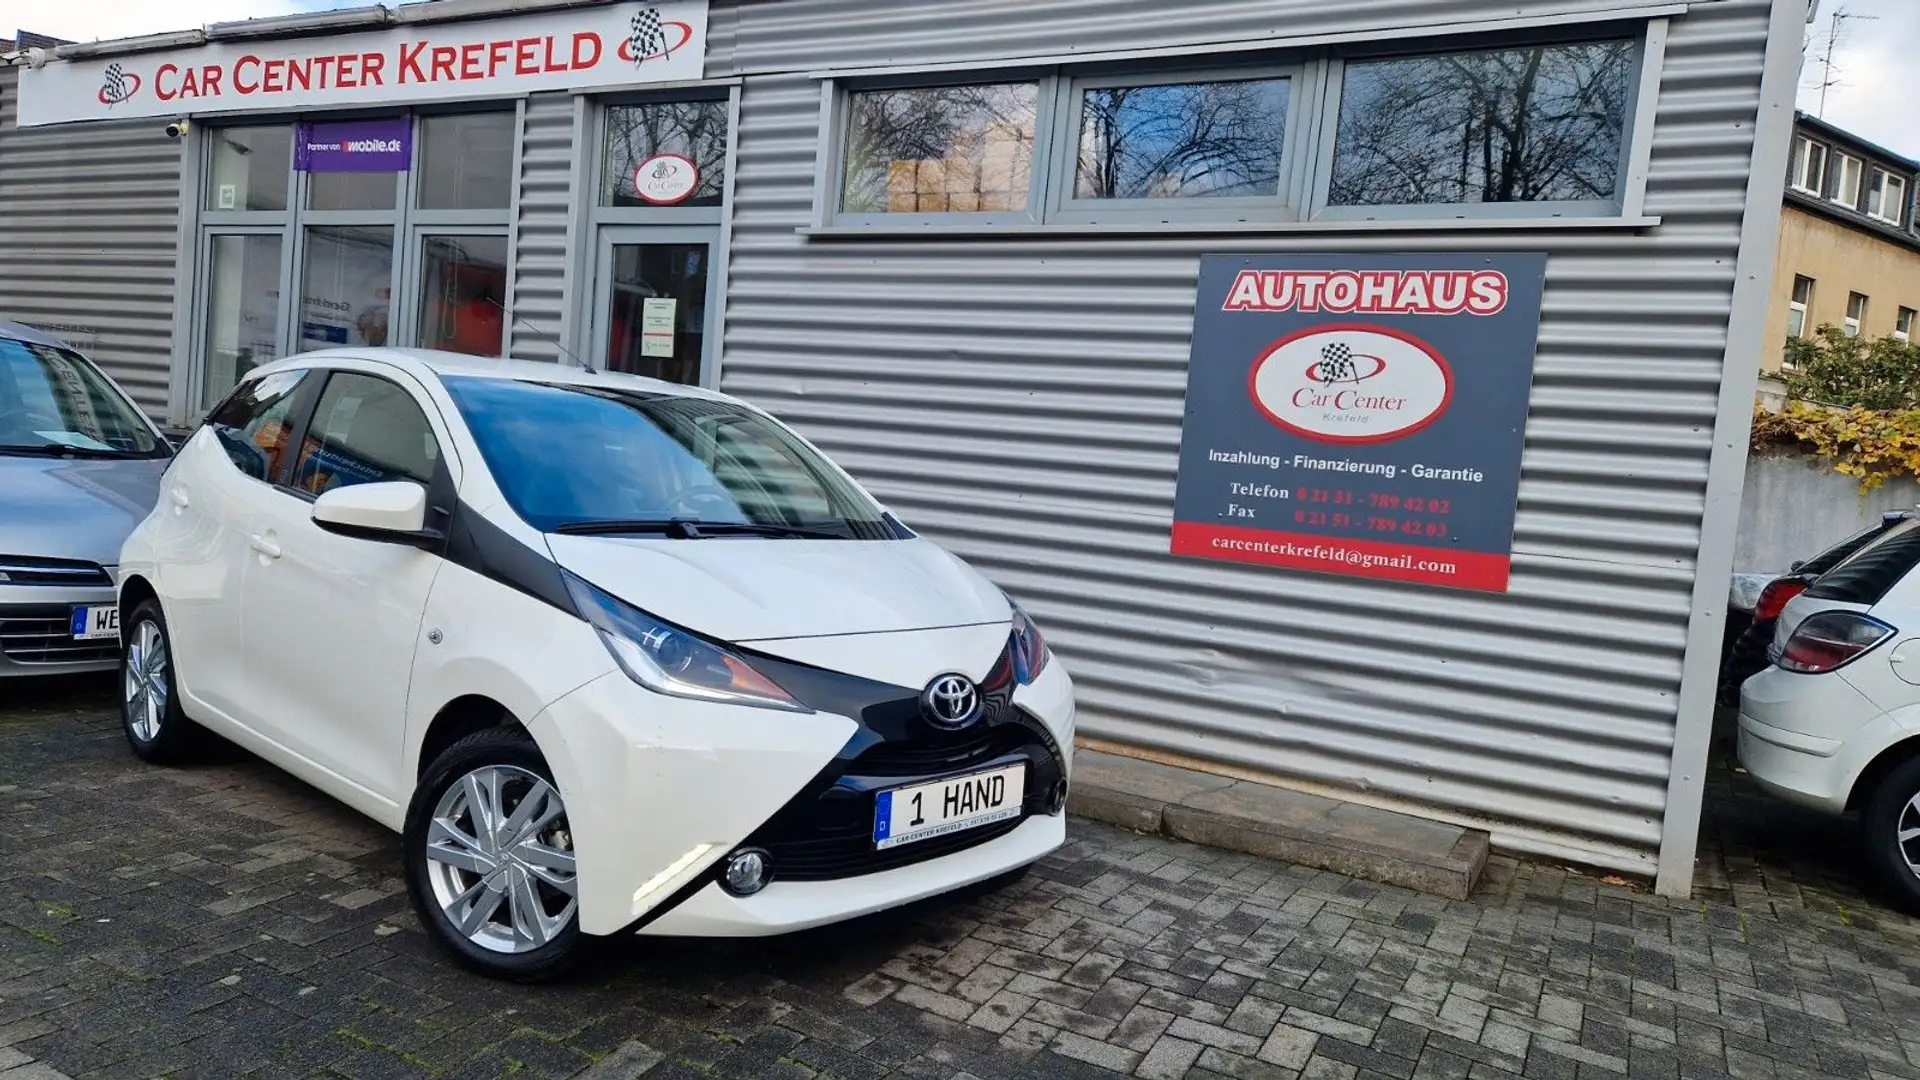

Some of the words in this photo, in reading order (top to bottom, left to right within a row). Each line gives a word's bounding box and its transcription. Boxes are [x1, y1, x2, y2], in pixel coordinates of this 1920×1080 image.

[154, 63, 223, 101] CAR
[232, 54, 385, 95] CENTER
[397, 32, 604, 84] KREFELD
[307, 142, 329, 151] Partner
[329, 143, 341, 151] von
[347, 138, 402, 153] mobile.de
[1222, 269, 1509, 316] AUTOHAUS
[1292, 387, 1331, 408] Car
[1334, 389, 1407, 411] Center
[1322, 412, 1371, 424] Krefeld
[1208, 449, 1280, 469] Inzahlung
[1293, 454, 1397, 478] Finanzierung
[1411, 463, 1484, 483] Garantie
[1230, 481, 1290, 500] Telefon
[1311, 489, 1329, 504] 21
[1334, 490, 1353, 506] 51
[1369, 492, 1400, 510] 789
[1404, 497, 1425, 513] 42
[1429, 499, 1451, 514] 02
[1227, 503, 1256, 519] Fax
[1308, 511, 1326, 526] 21
[1331, 513, 1351, 528] 51
[1367, 516, 1397, 532] 789
[1401, 520, 1422, 536] 42
[1211, 536, 1457, 575] carcenterkrefeld@gmail.com
[96, 609, 118, 630] WE
[910, 792, 925, 826] 1
[944, 775, 1005, 819] HAND
